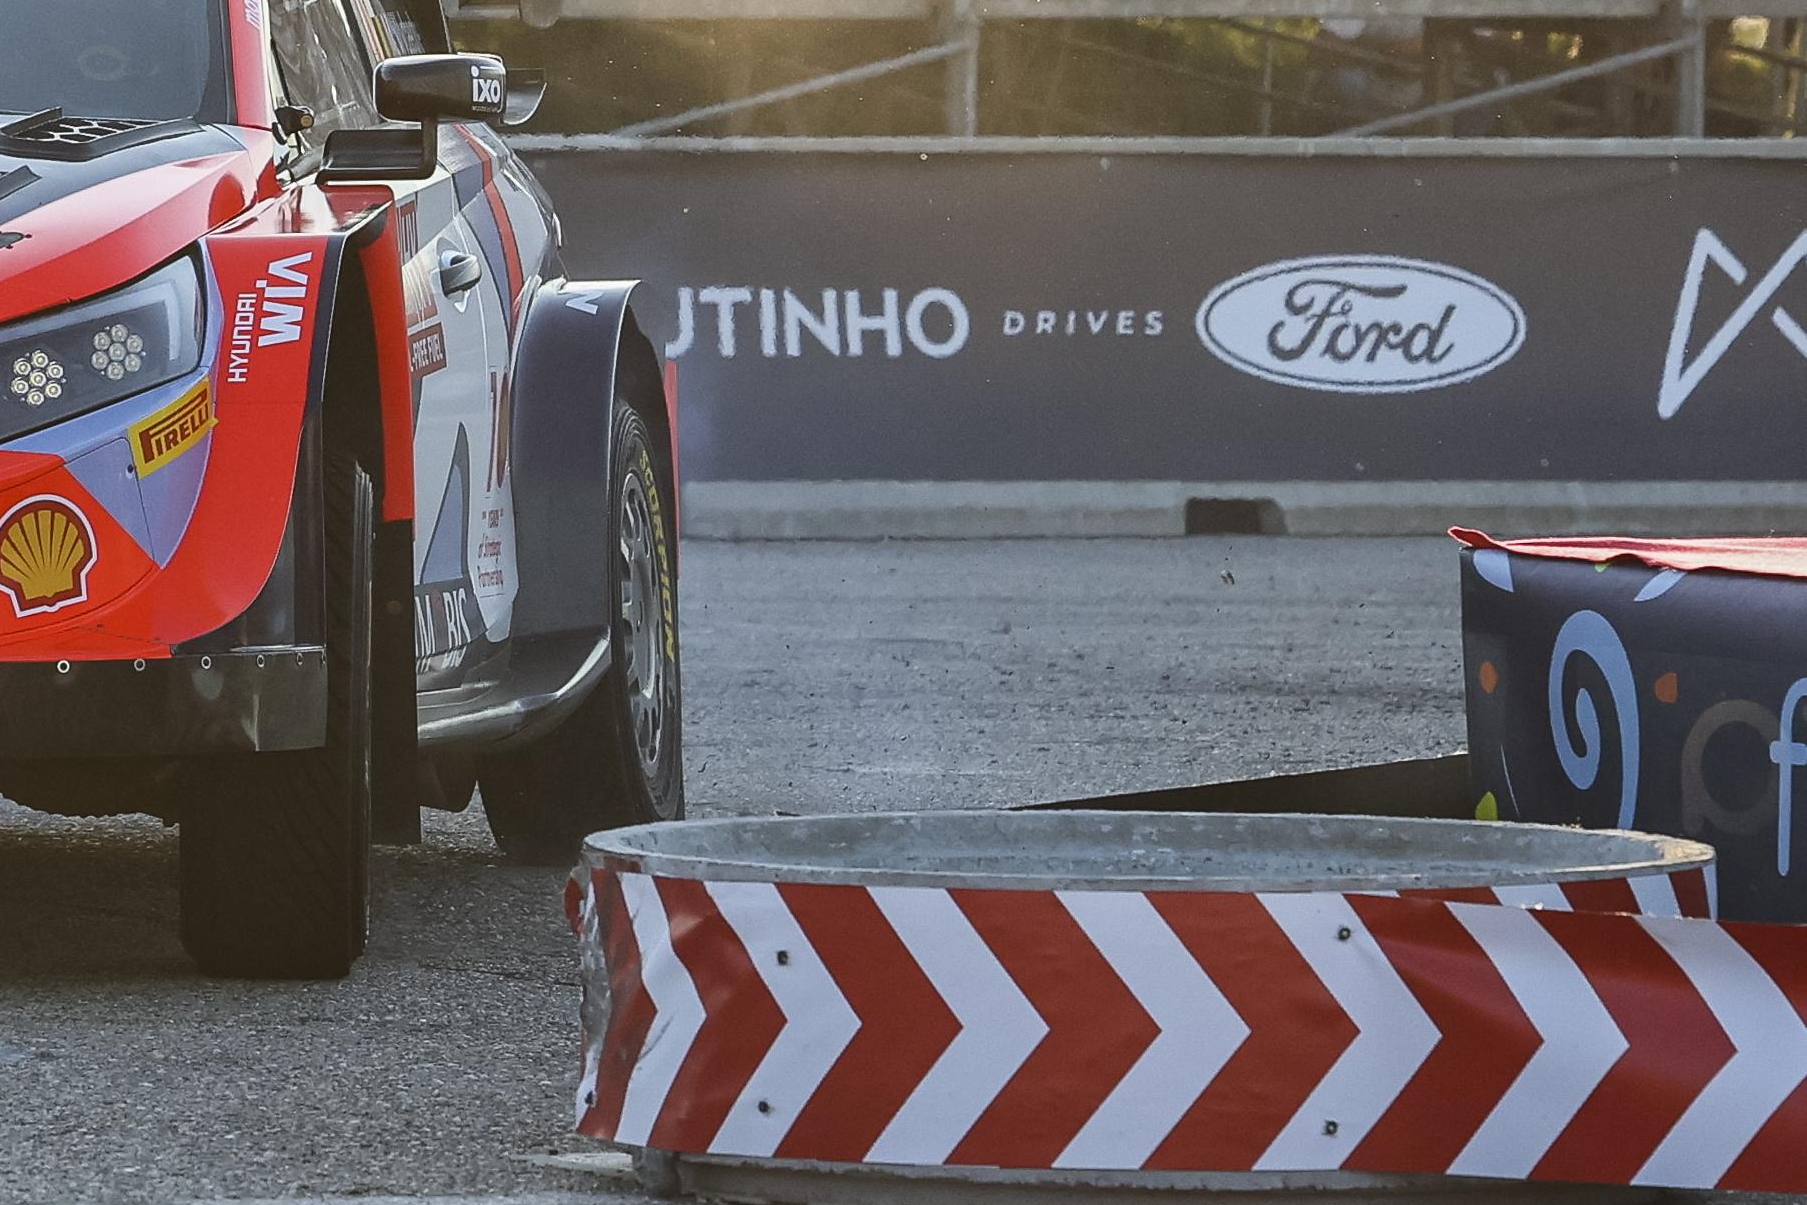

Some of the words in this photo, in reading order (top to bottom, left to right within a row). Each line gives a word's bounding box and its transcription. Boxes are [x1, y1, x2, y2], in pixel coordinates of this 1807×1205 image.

[227, 293, 258, 383] HYUNDAI
[1002, 308, 1166, 337] DRIVES
[1267, 277, 1456, 365] Ford
[139, 387, 210, 465] PIRELLI
[639, 449, 675, 663] SCORPION
[415, 587, 472, 657] MBIS
